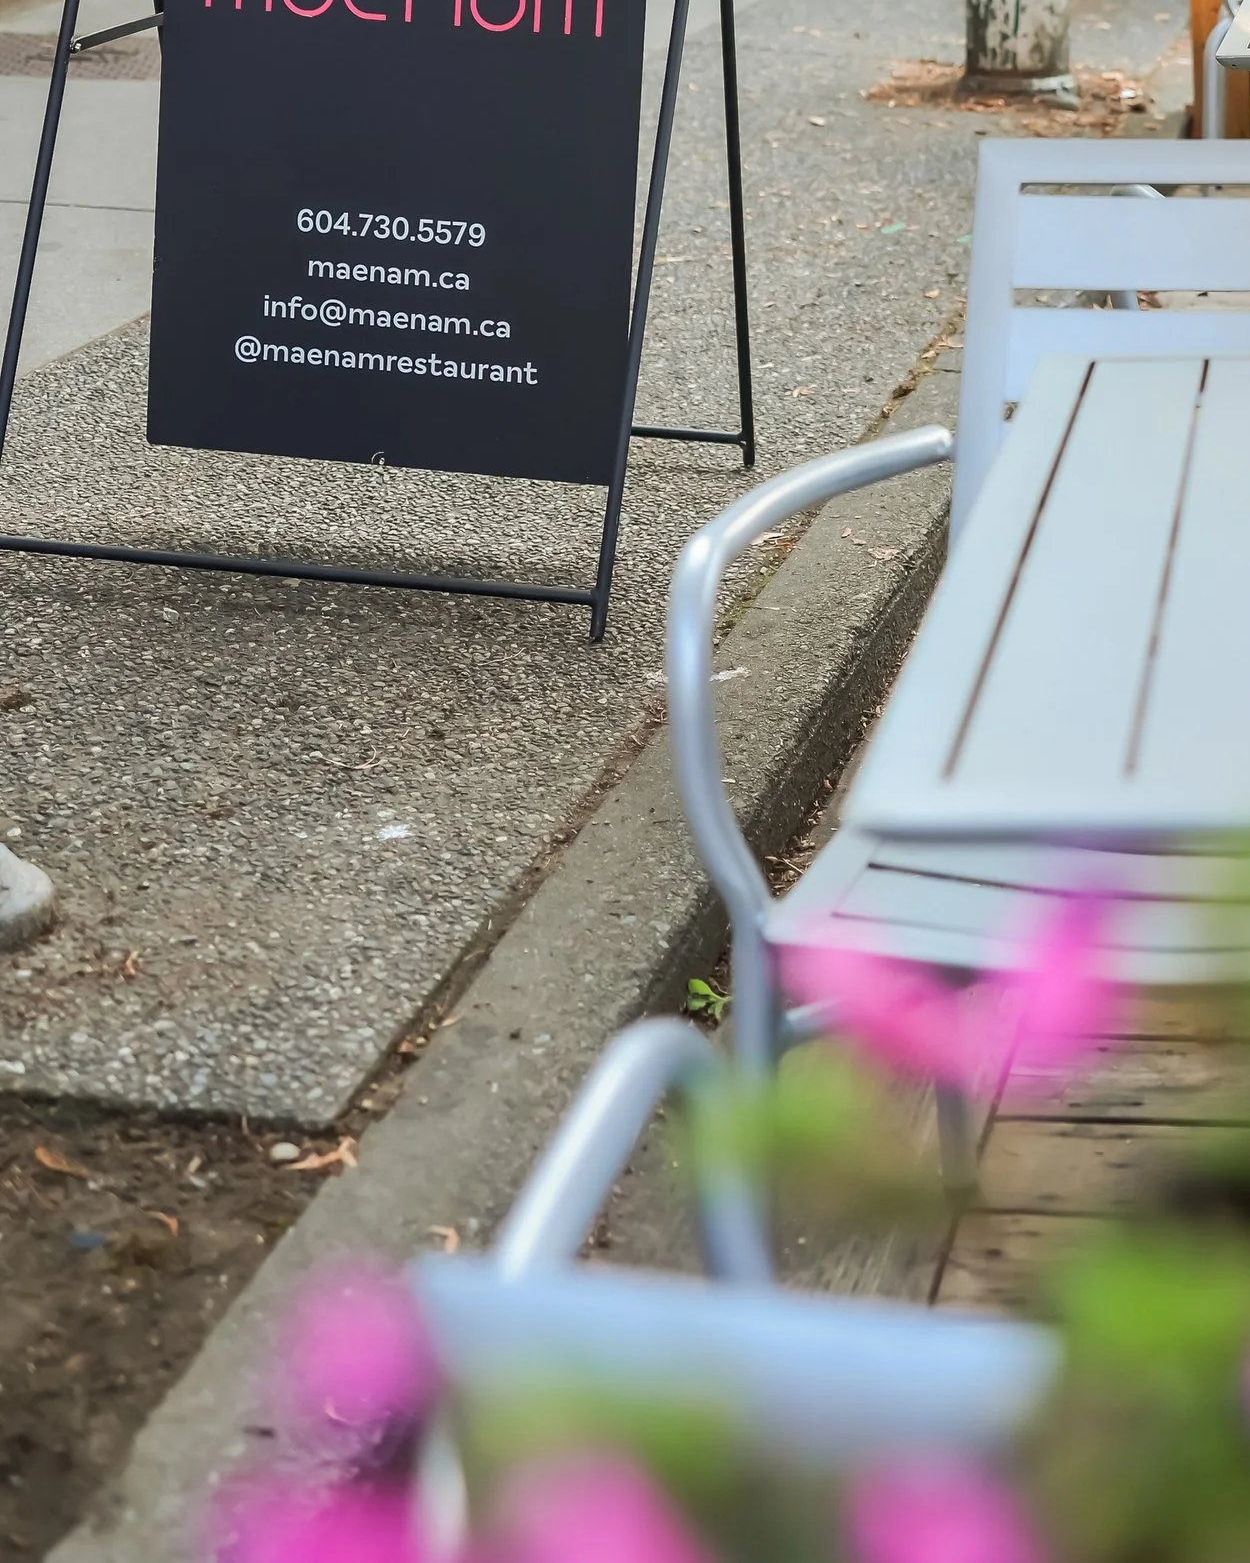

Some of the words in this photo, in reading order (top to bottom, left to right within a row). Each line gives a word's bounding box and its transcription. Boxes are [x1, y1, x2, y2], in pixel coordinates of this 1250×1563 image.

[297, 208, 486, 248] 604.730.5579
[308, 260, 470, 291] maenam.ca
[263, 294, 511, 339] info@maenam.ca
[234, 335, 538, 385] @maenamrestaurant
